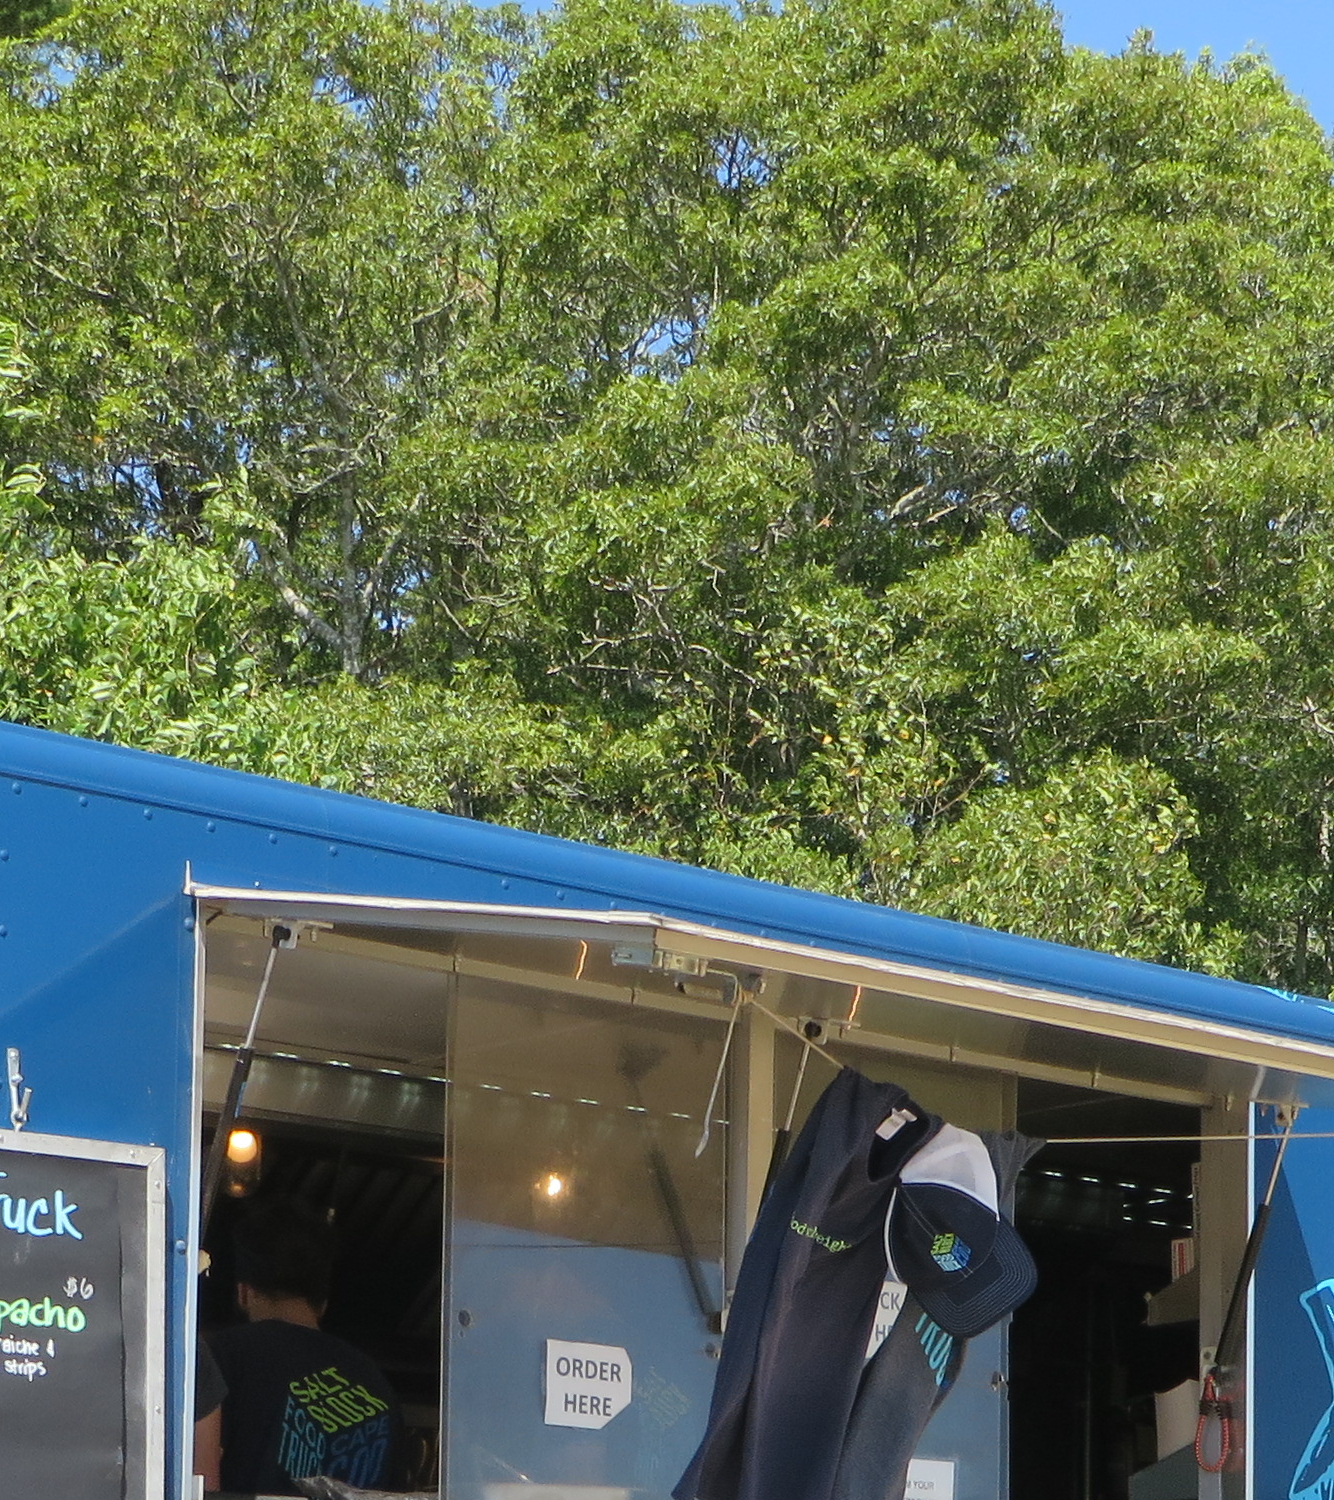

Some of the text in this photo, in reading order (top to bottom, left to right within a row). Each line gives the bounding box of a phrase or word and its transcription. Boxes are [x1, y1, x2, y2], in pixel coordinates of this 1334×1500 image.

[63, 1276, 94, 1299] $6
[880, 1292, 900, 1311] CK
[4, 1358, 47, 1383] strips
[556, 1356, 622, 1383] ORDER
[289, 1367, 350, 1403] SALT
[307, 1384, 389, 1433] BLOCK
[563, 1392, 612, 1417] HERE
[284, 1396, 326, 1460] FOOD
[331, 1414, 390, 1457] CAPE
